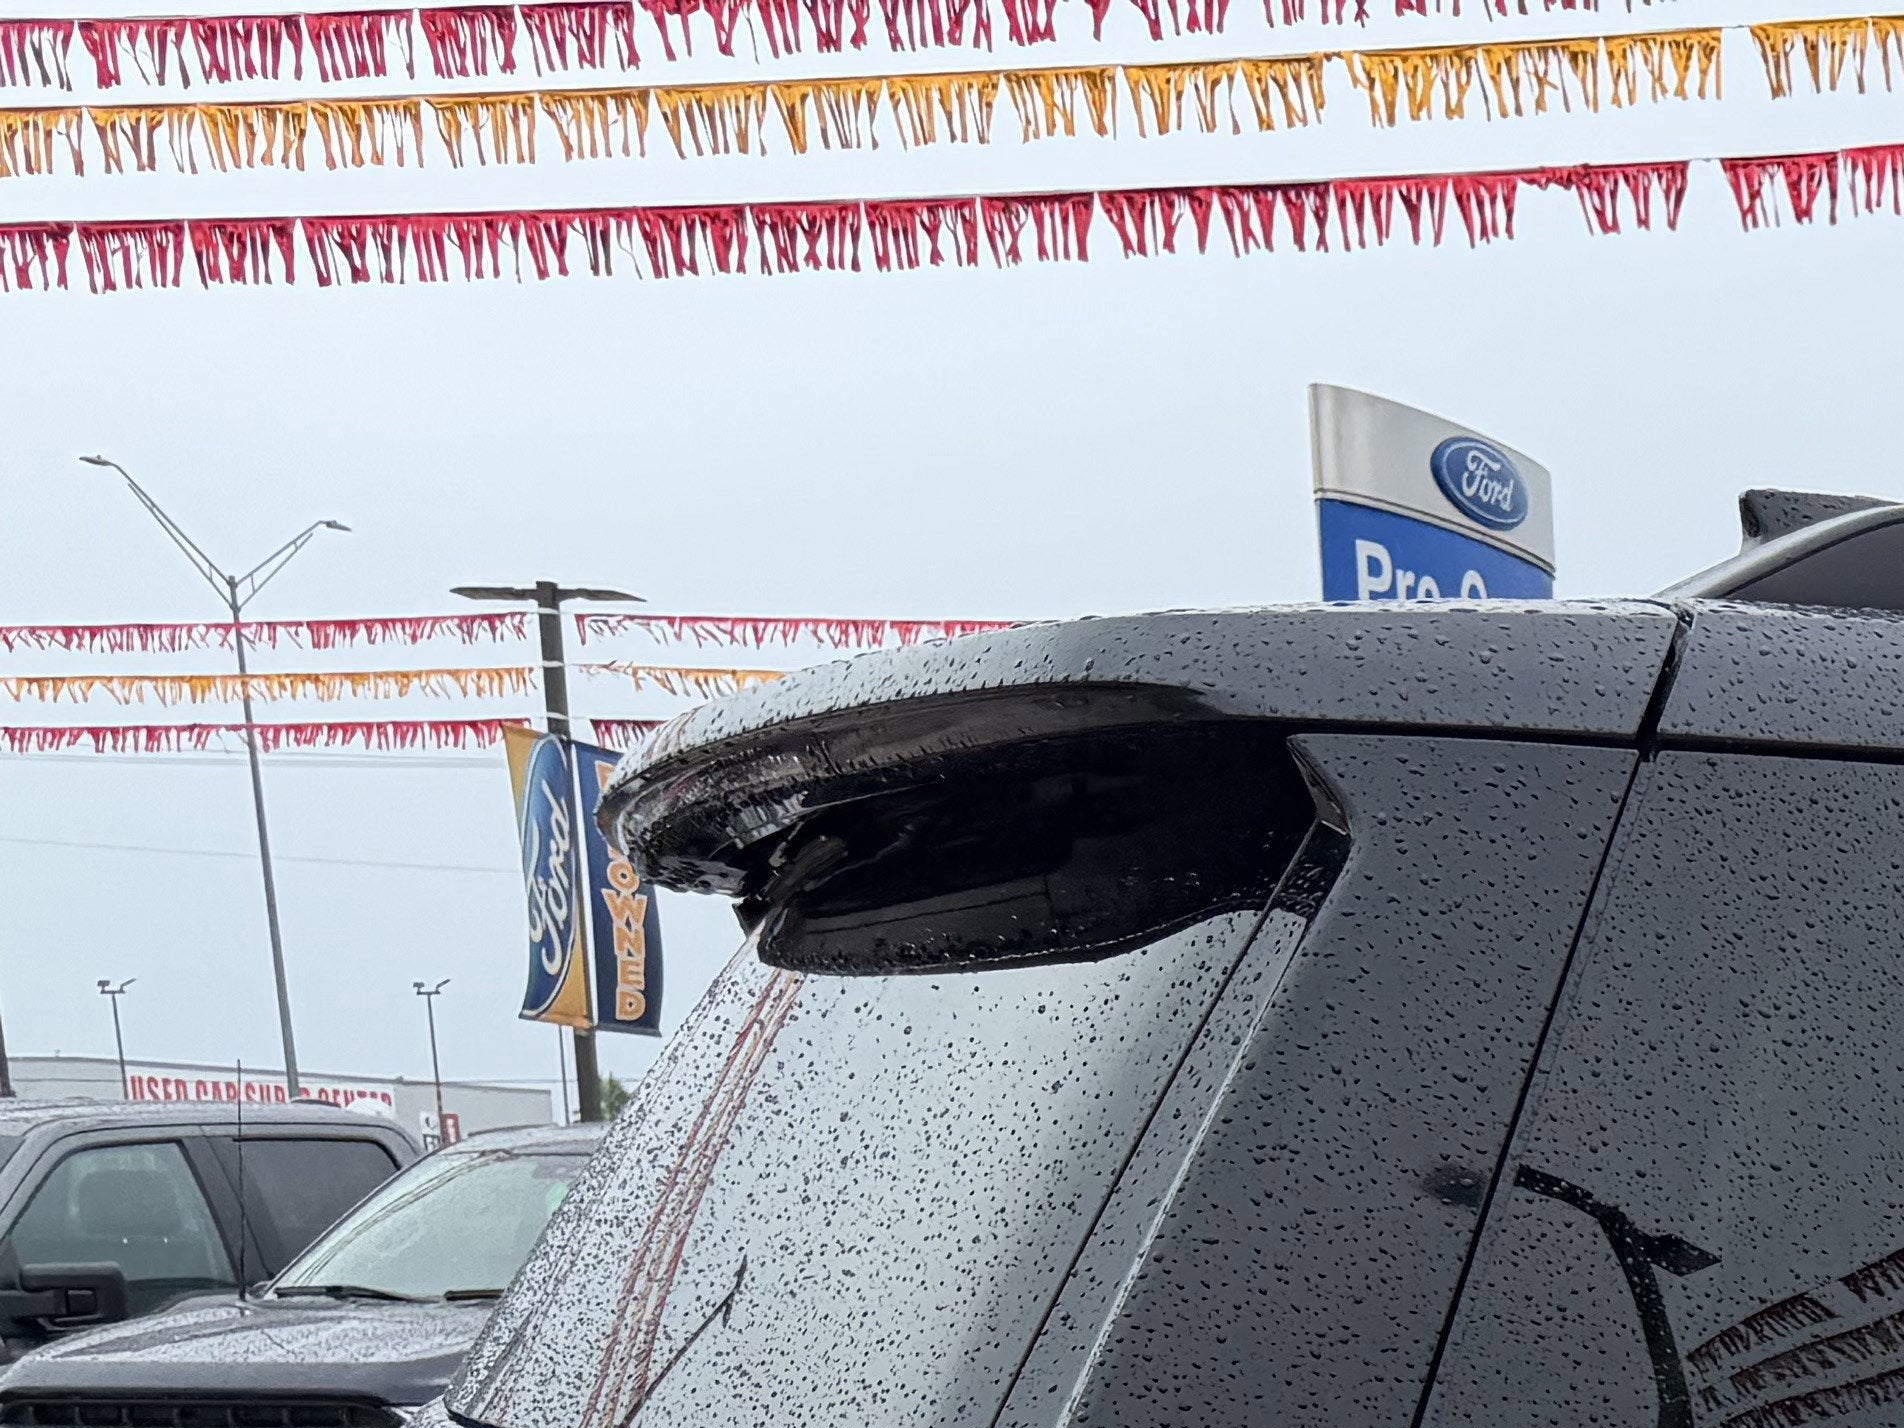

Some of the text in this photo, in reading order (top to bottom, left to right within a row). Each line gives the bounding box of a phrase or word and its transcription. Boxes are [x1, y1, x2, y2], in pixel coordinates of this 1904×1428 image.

[1461, 449, 1515, 513] Ford
[526, 778, 570, 976] Ford
[601, 846, 648, 1021] OWNED
